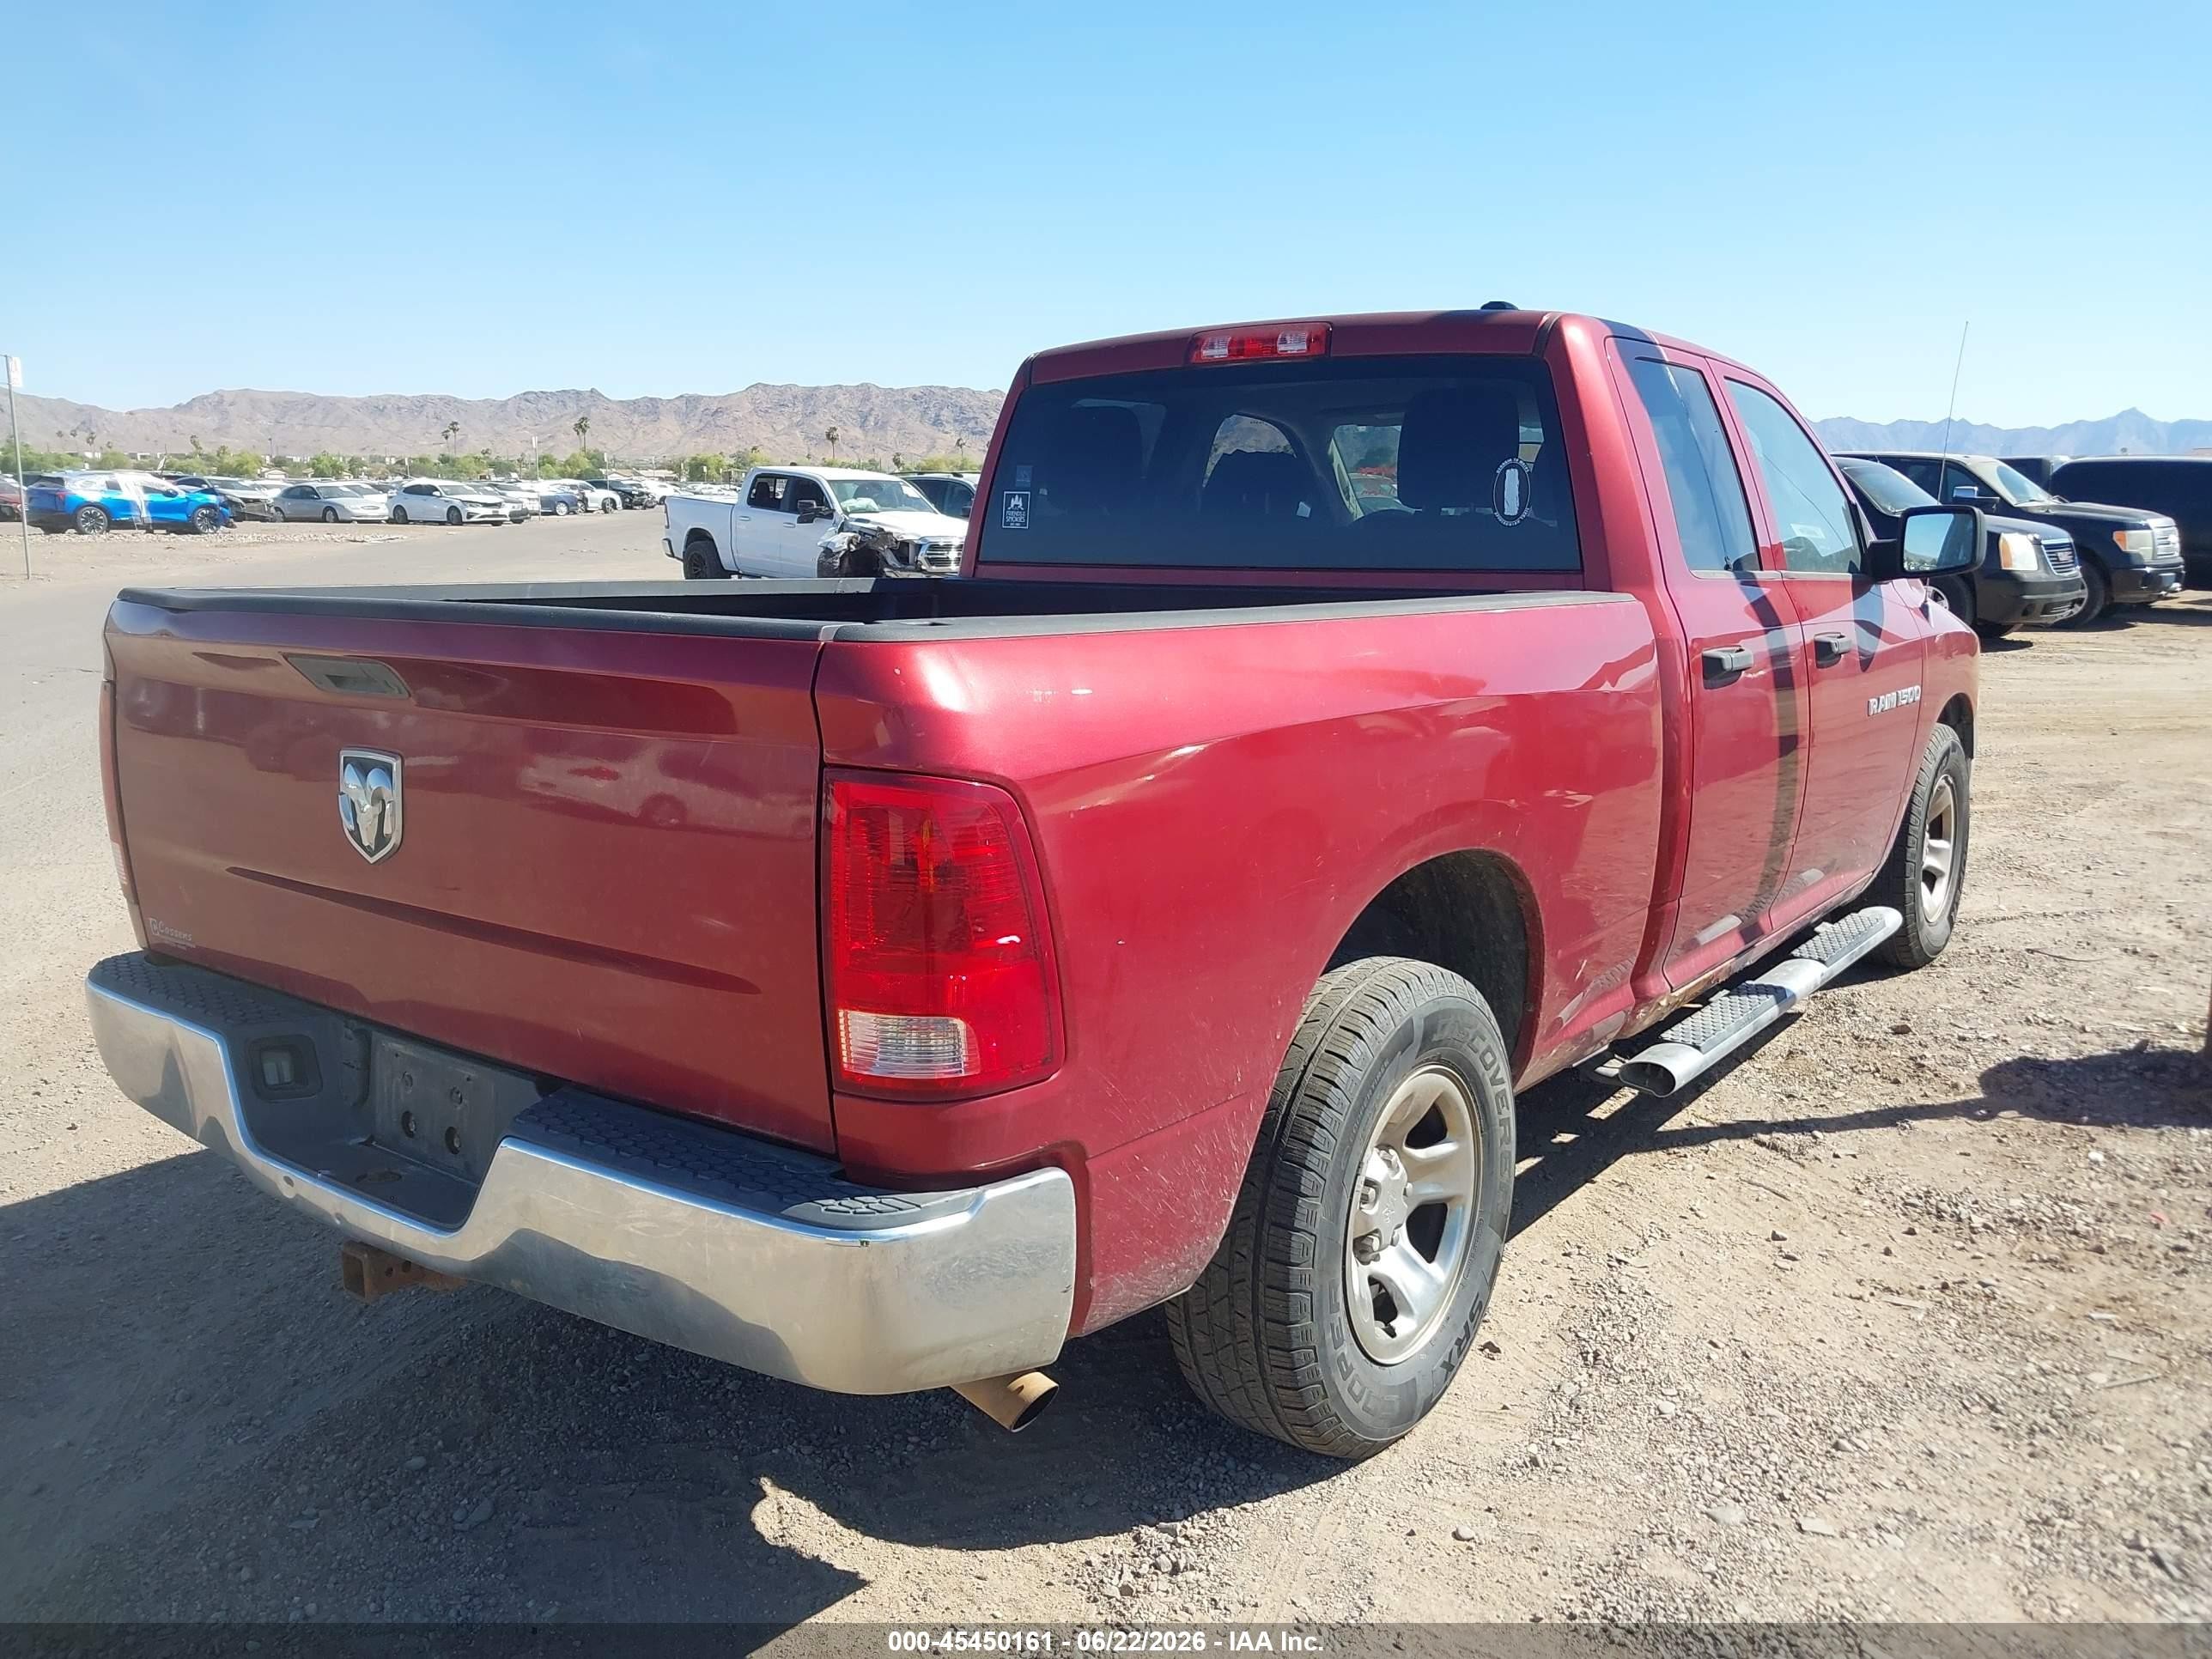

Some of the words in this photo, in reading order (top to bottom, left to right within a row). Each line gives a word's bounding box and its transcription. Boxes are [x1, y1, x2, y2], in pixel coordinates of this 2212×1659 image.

[1869, 692, 1897, 715] RAM
[1897, 685, 1921, 707] 1500
[1431, 1018, 1513, 1214] DISCOVERER
[1328, 1279, 1402, 1420] COOPER
